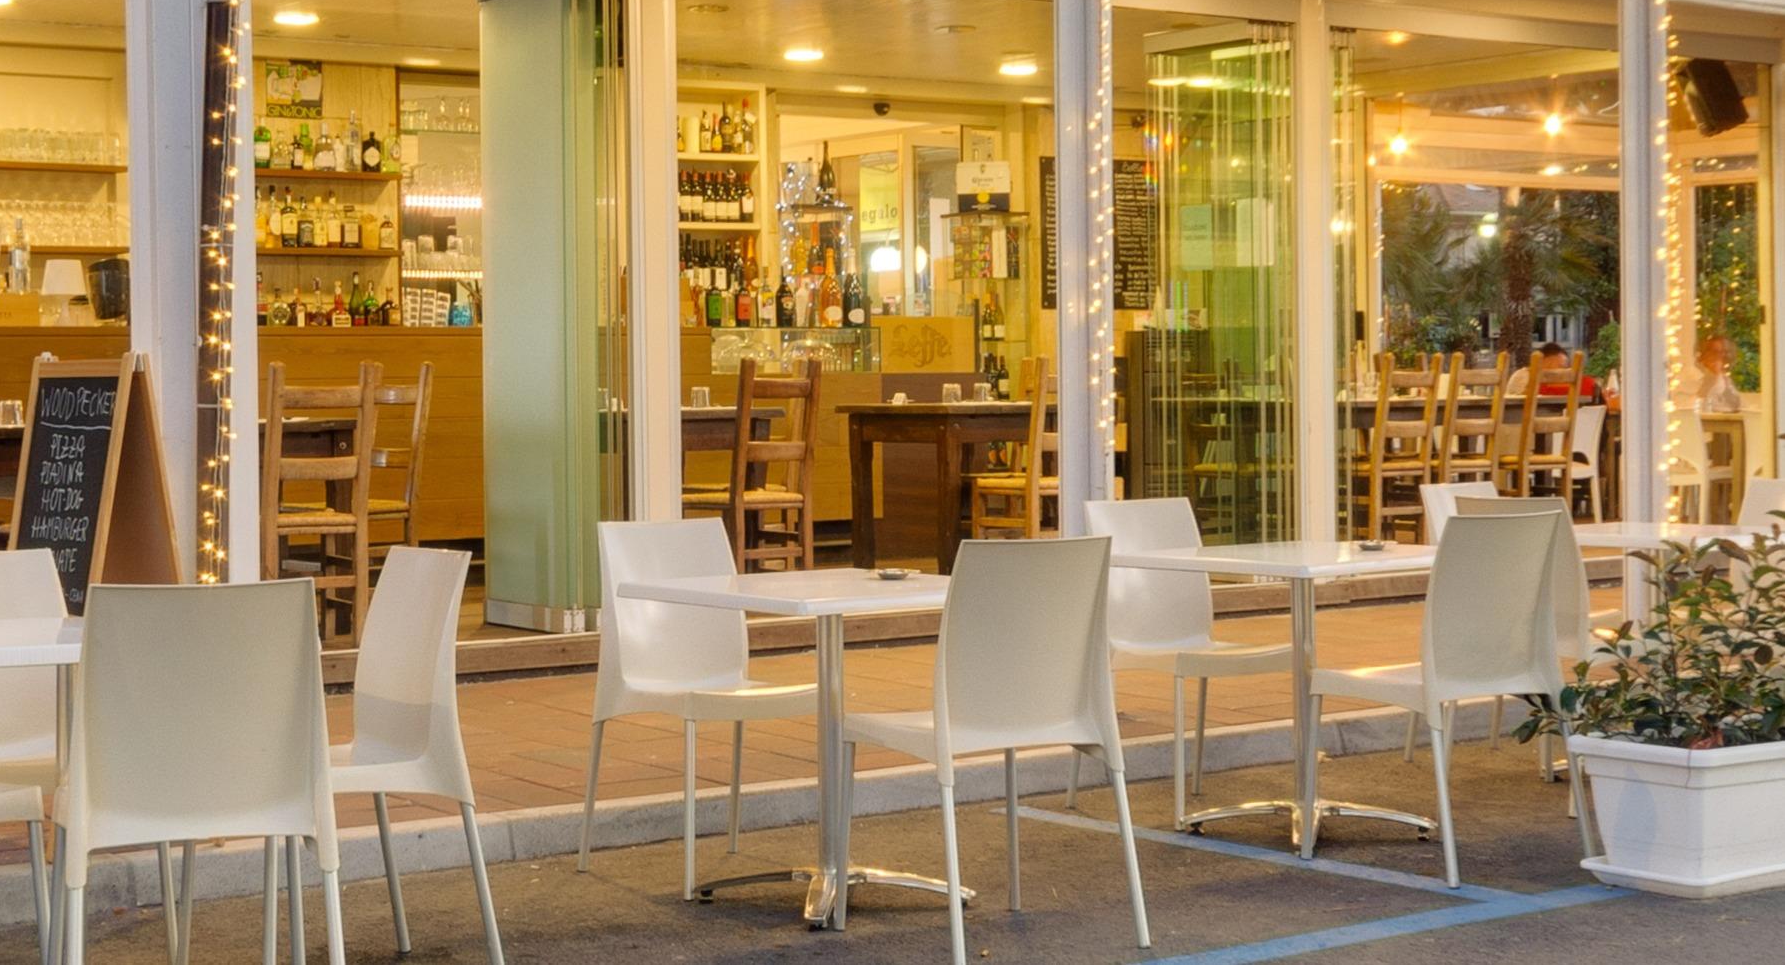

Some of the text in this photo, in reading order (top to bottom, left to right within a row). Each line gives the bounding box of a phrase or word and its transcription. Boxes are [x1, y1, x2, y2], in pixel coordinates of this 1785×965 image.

[50, 433, 86, 460] PIZZA
[40, 460, 84, 485] PIADINA
[31, 515, 90, 542] HAMBURGER
